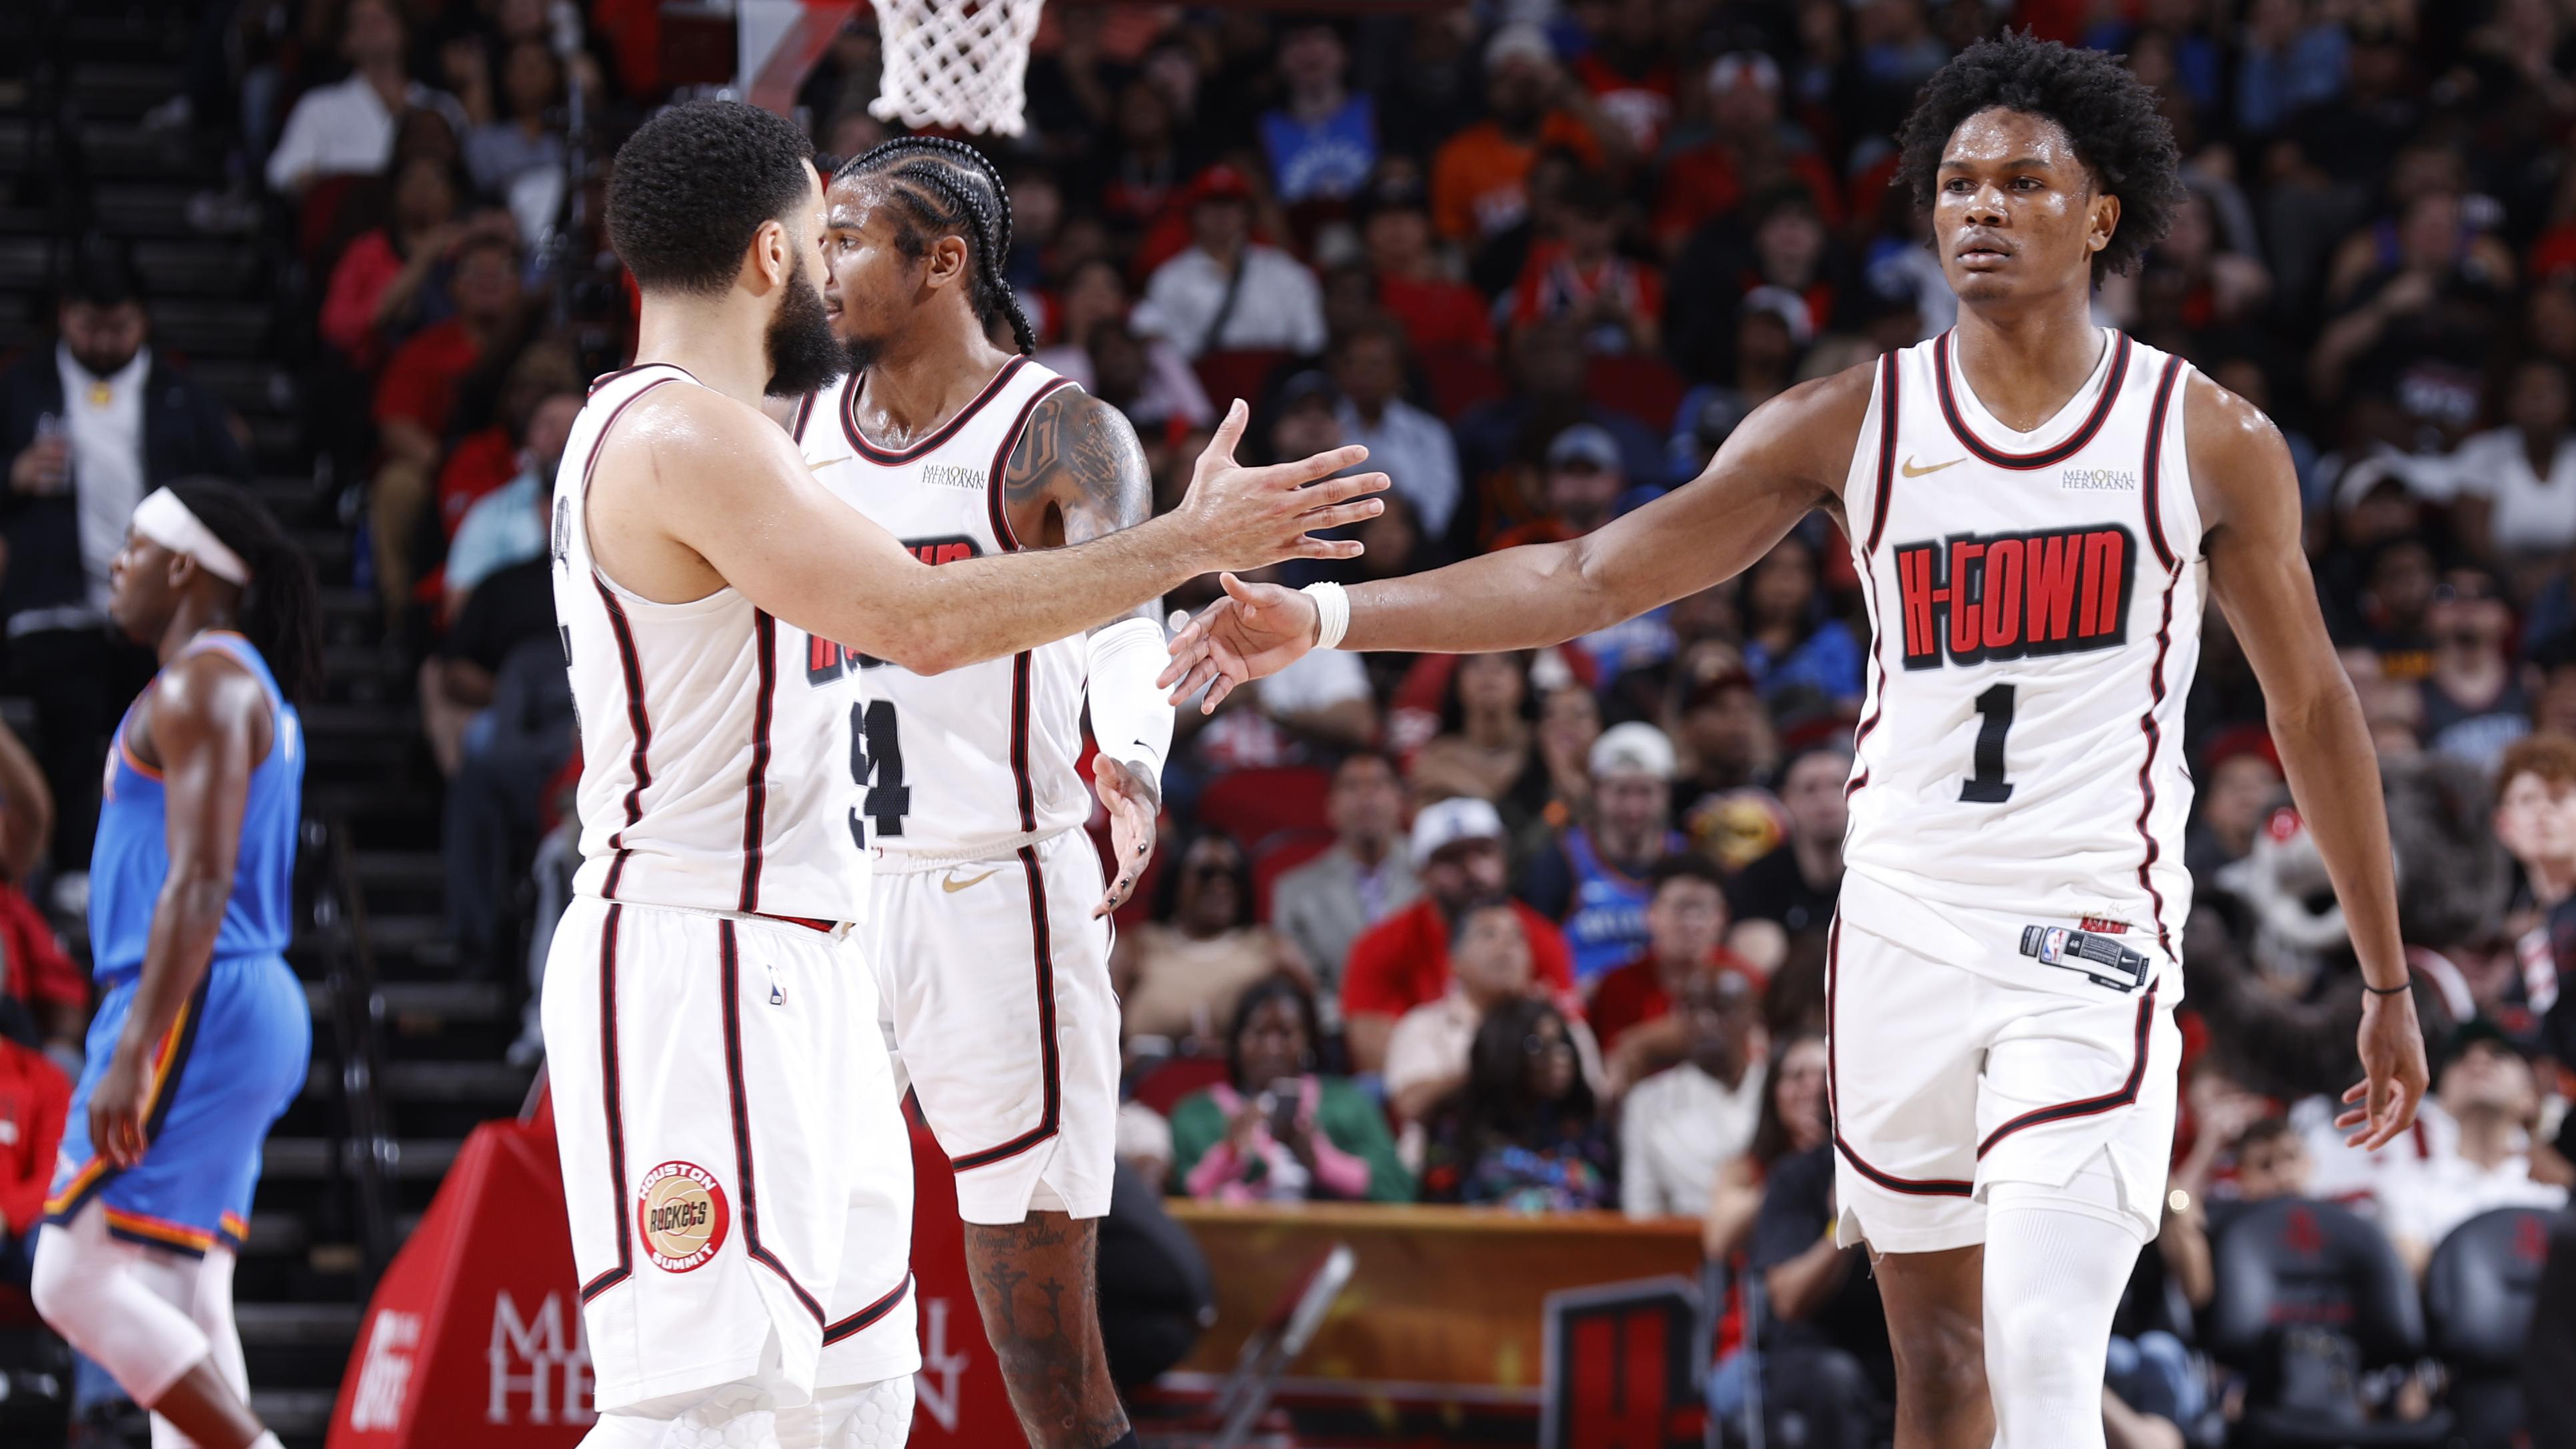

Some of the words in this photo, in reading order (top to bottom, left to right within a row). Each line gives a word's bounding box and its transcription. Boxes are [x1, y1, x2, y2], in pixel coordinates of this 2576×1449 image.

[922, 472, 986, 490] HERMANN
[924, 464, 985, 481] MEMORIAL
[2063, 469, 2134, 481] MEMORIAL
[2062, 477, 2134, 490] HERMANN
[1957, 683, 2016, 803] 1
[639, 1164, 717, 1200] HOUSTON
[651, 1242, 715, 1270] SUMMIT
